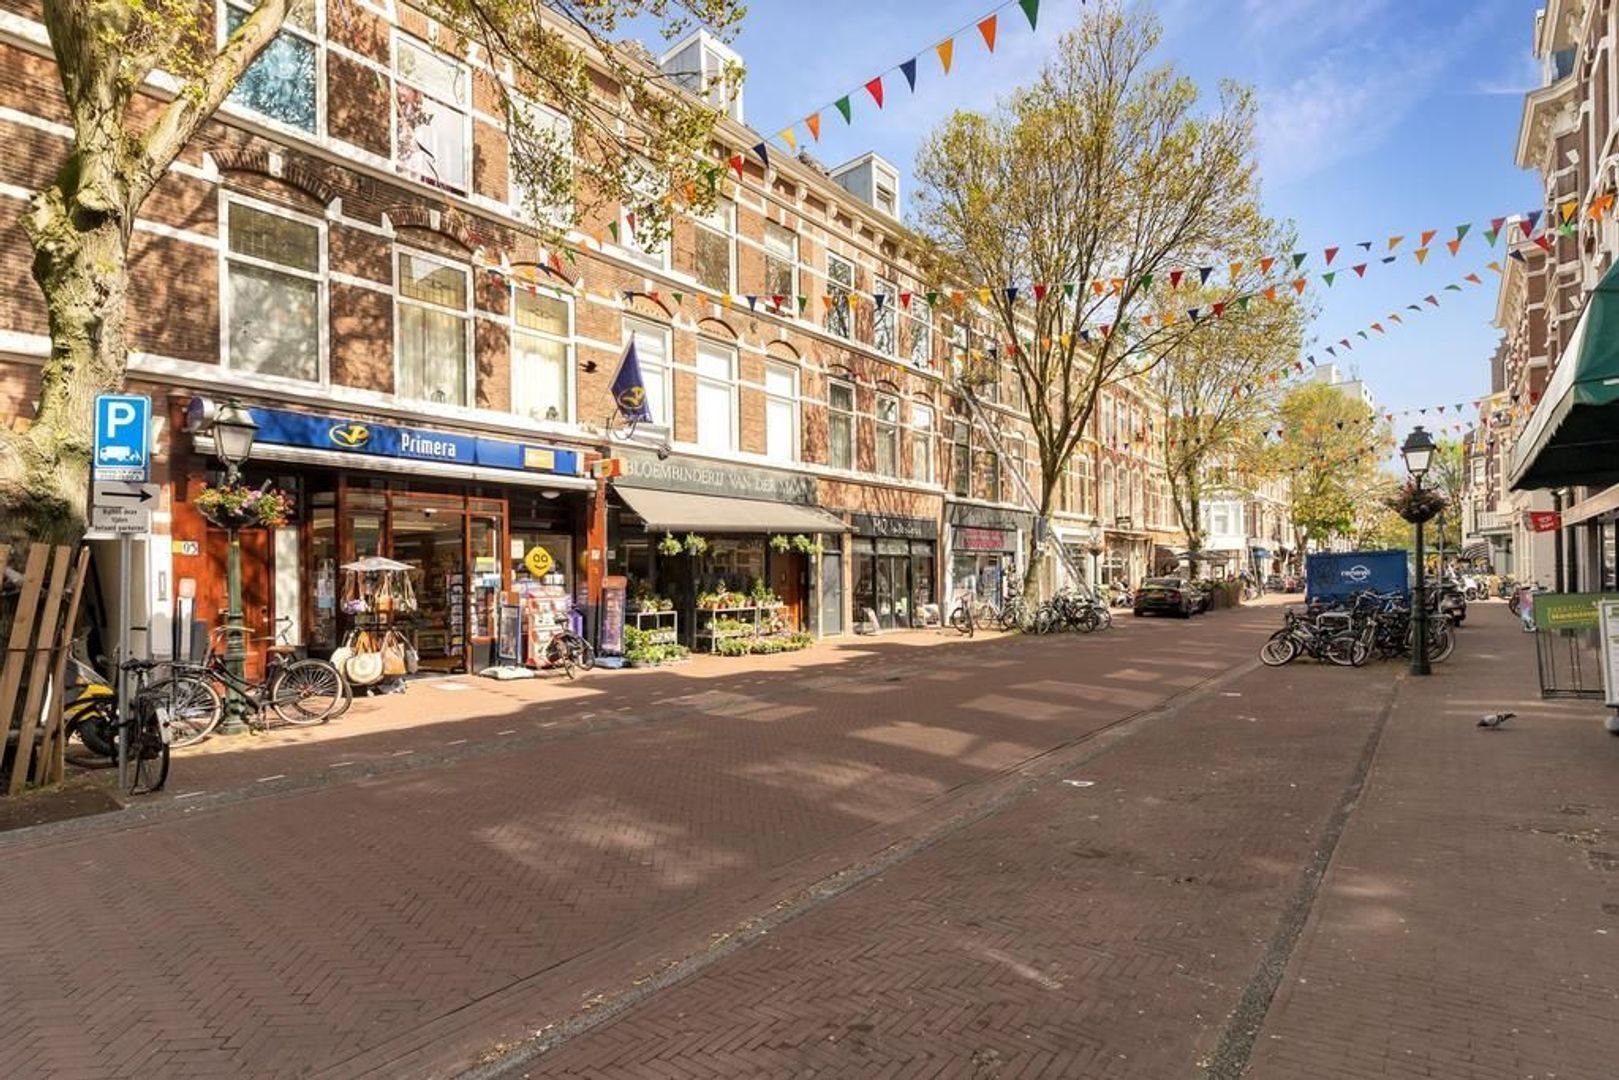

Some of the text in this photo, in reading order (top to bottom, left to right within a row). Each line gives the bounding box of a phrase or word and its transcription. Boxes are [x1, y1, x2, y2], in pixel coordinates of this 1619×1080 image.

[107, 402, 136, 438] P
[401, 433, 457, 458] Primera
[626, 459, 724, 486] BLOEMBINDERIJ
[729, 473, 751, 490] VAN
[755, 478, 777, 493] DER
